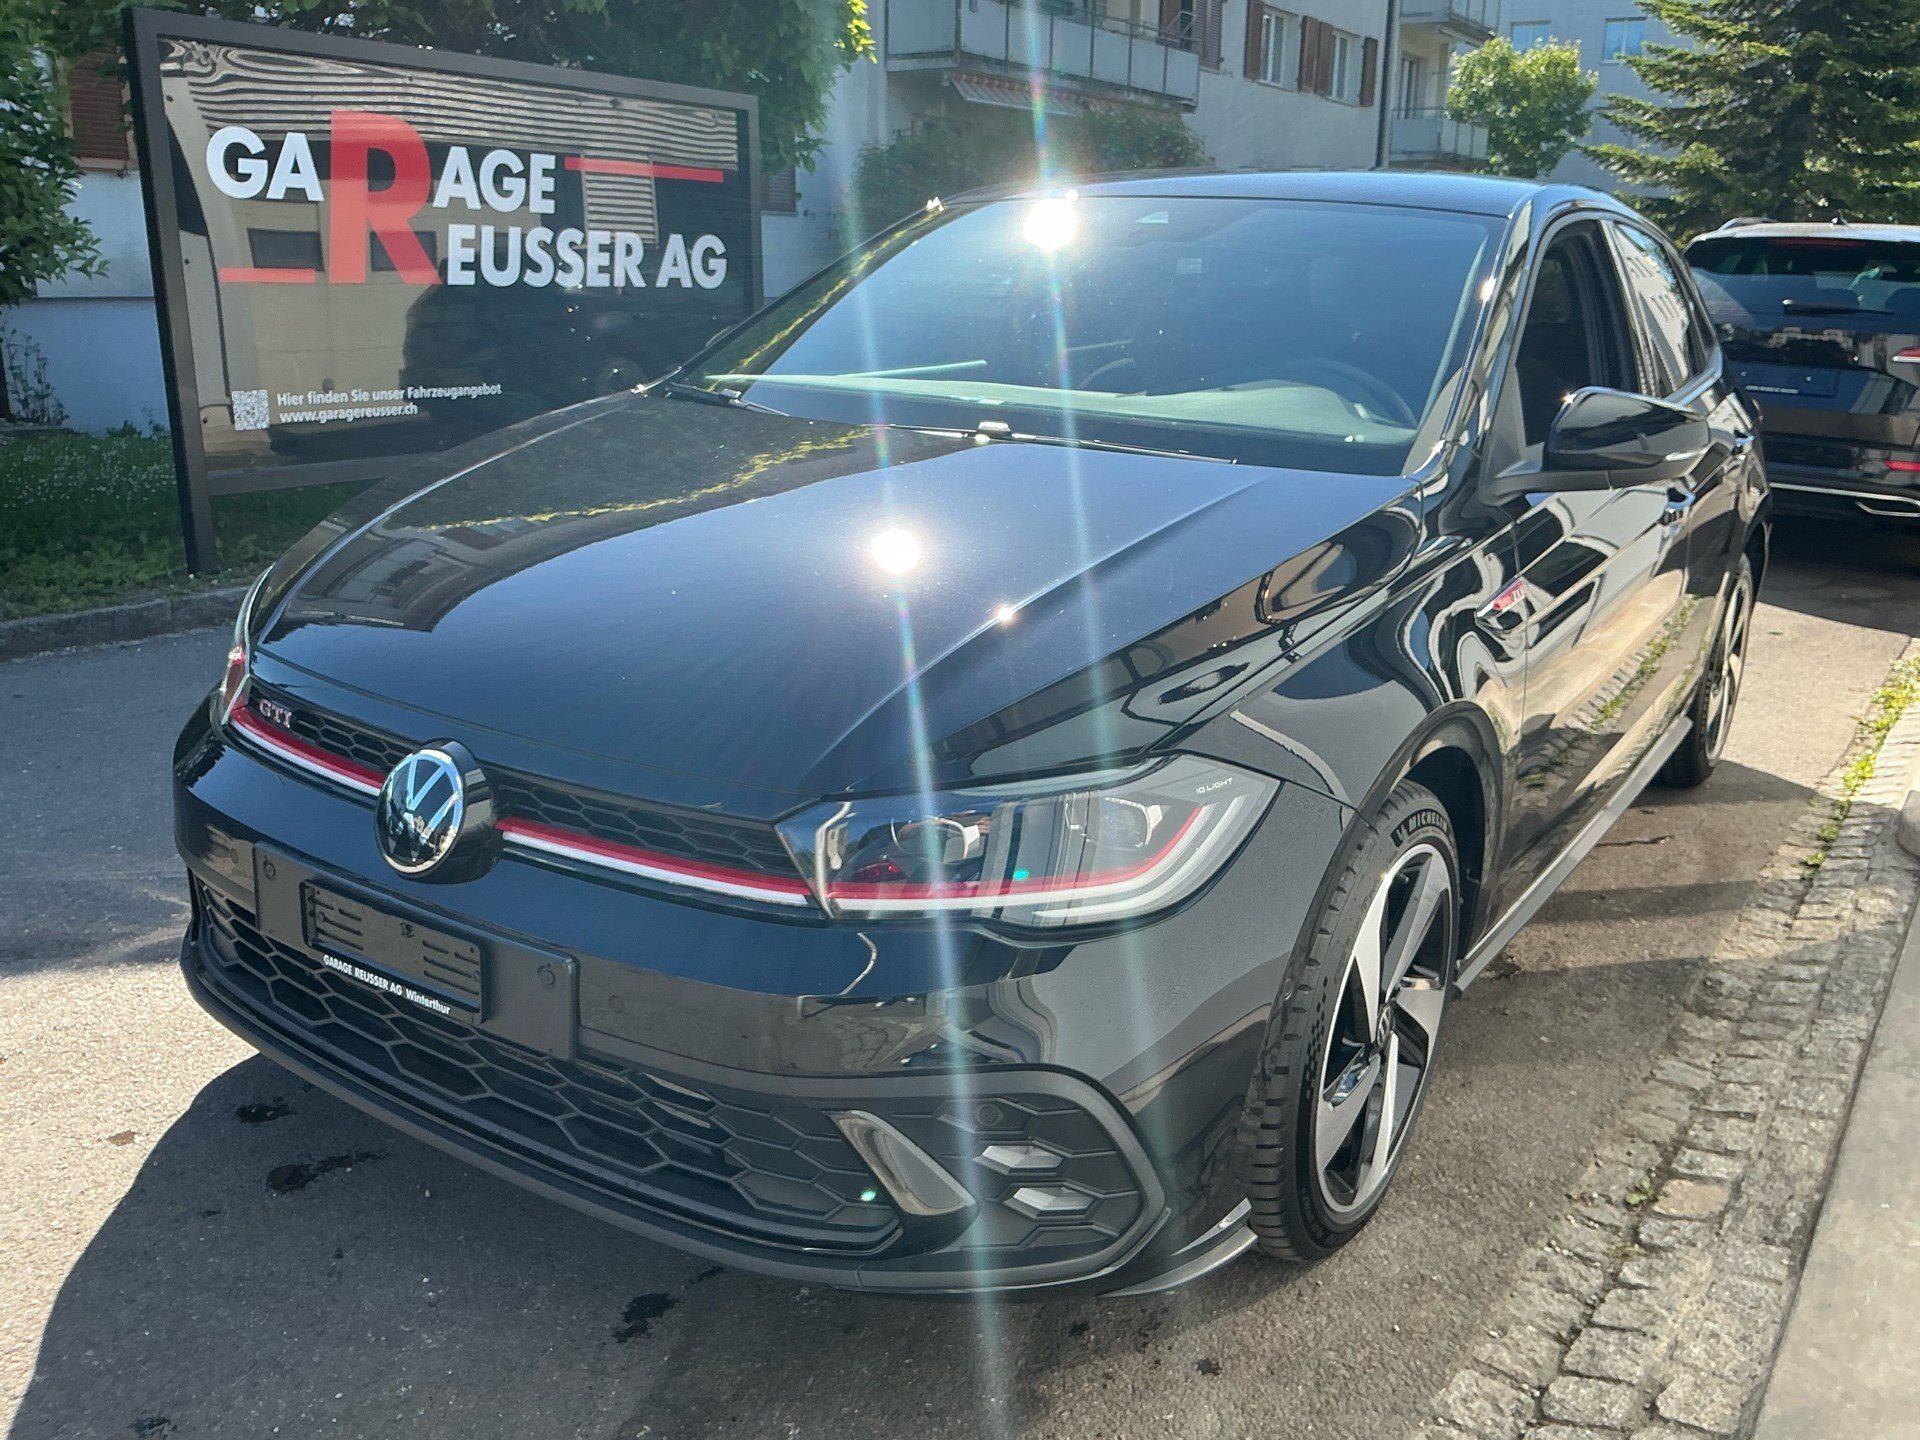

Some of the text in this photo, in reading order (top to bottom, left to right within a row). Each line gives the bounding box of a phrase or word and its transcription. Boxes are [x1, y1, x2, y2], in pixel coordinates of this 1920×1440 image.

[655, 233, 728, 291] AG
[277, 383, 502, 407] Hier finden Sie unser Fahrzeugangebot
[279, 402, 418, 424] www.garagereusser.ch
[260, 698, 292, 728] GTI
[323, 954, 451, 1015] GARAGE REUSSER AG Winterthur
